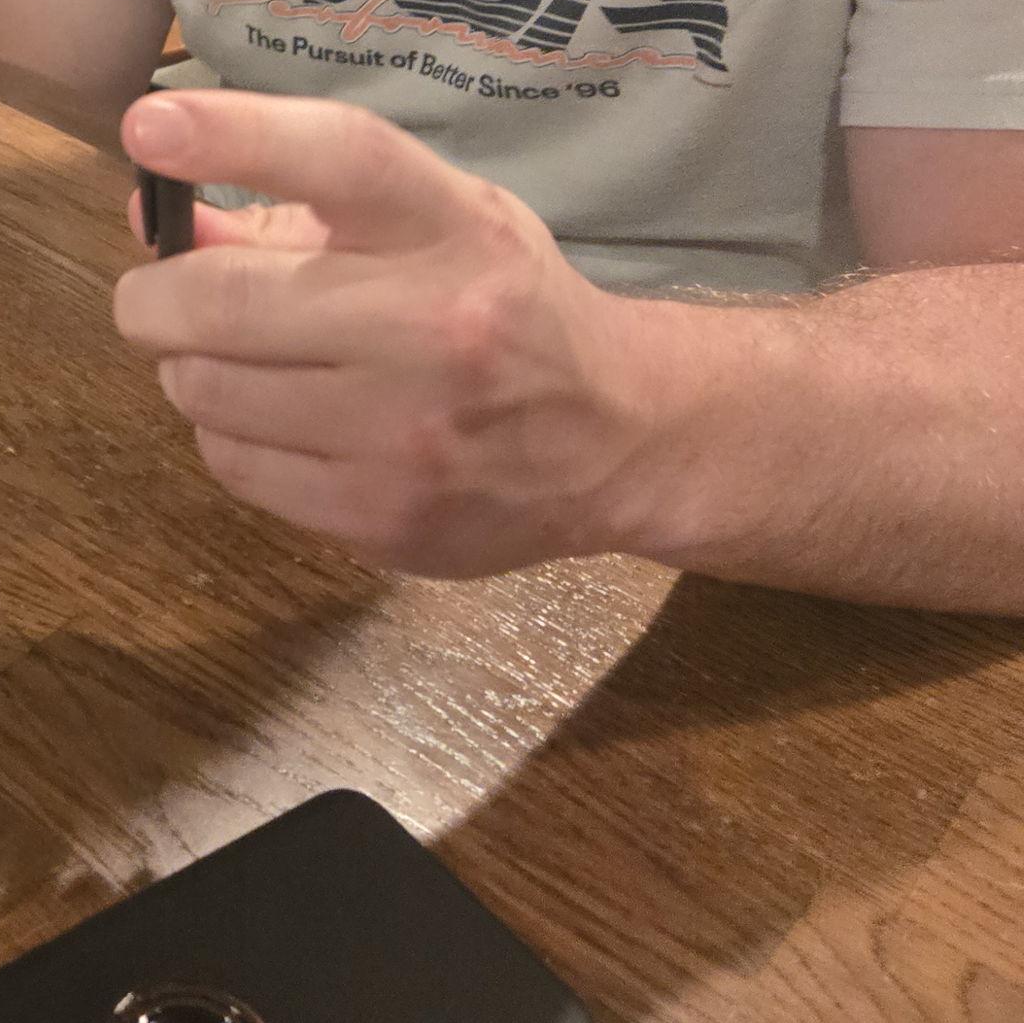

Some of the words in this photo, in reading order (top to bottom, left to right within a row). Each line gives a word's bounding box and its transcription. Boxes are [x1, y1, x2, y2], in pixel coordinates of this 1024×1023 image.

[245, 24, 287, 53] The
[291, 36, 384, 67] Pursuit
[390, 50, 419, 71] of
[419, 52, 475, 93] Better
[478, 74, 560, 100] Since
